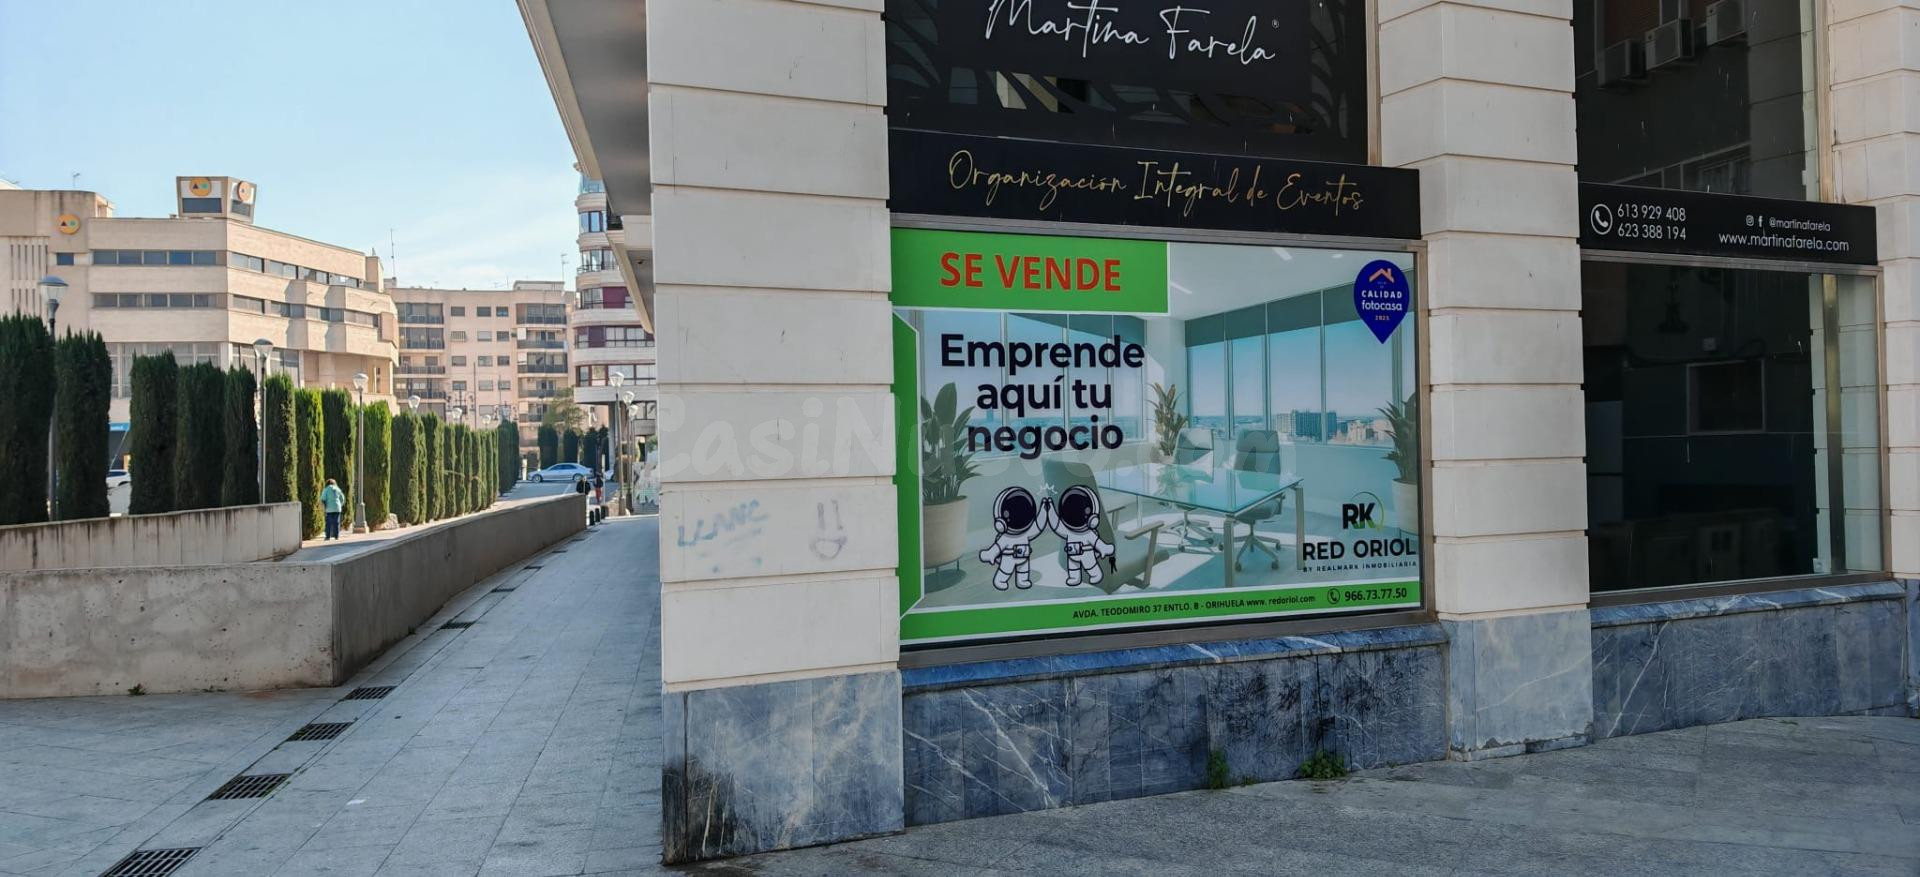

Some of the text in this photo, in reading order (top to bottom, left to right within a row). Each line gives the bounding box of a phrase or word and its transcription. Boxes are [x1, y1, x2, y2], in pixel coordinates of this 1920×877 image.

[985, 0, 1276, 65] Martina Farela
[1134, 160, 1239, 218] Integral
[1246, 164, 1268, 207] de
[1276, 173, 1363, 216] Eventos
[1617, 203, 1687, 222] 613 929 408
[1617, 223, 1687, 241] 623 388 194
[1768, 216, 1831, 232] @martinafarela
[1718, 232, 1850, 251] www.martinafarela.com
[940, 252, 1122, 291] SE VENDE
[1361, 290, 1402, 298] CALIDAD
[1361, 300, 1402, 311] fotocasa
[940, 333, 1145, 375] Emprende
[977, 376, 1111, 417] aquí tu
[967, 415, 1123, 460] negocio
[1342, 502, 1375, 530] RK
[1303, 538, 1417, 561] RED ORIOL
[1316, 564, 1359, 572] REALMARK
[1344, 588, 1407, 602] 966.73.77.50
[1072, 608, 1099, 619] AVDA.
[1101, 605, 1150, 616] TEODOMIRO
[1152, 604, 1162, 613] 37
[1205, 598, 1244, 609] ORIHUELA
